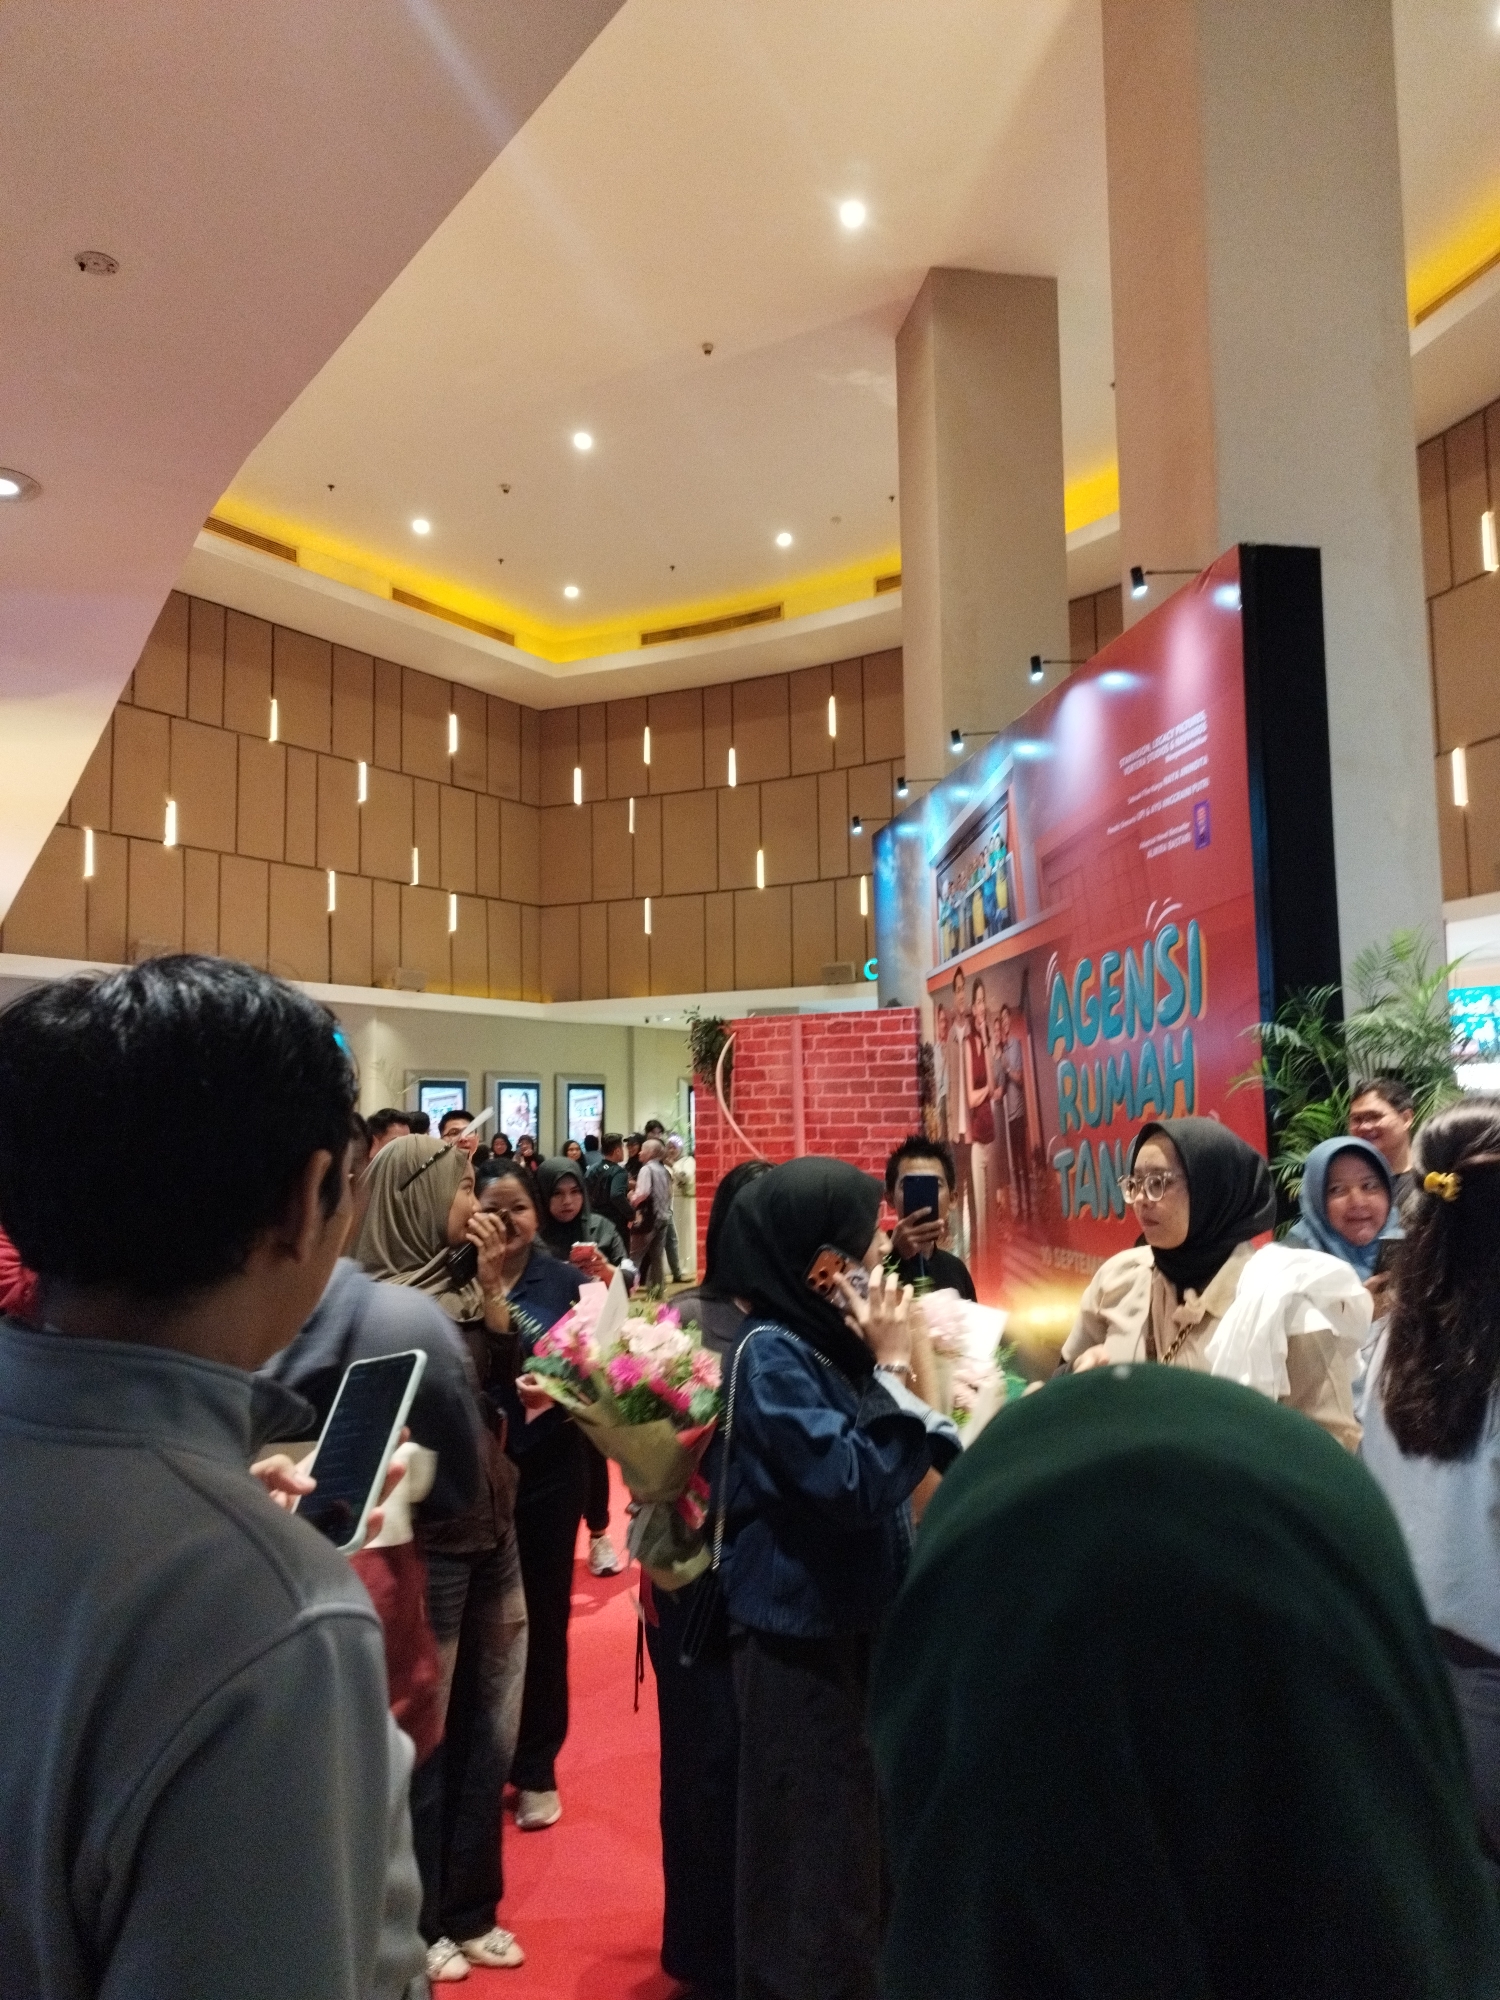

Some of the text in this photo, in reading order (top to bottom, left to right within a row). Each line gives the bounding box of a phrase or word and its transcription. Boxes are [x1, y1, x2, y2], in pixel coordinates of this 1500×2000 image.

[1047, 918, 1205, 1057] AGENSI
[1057, 1027, 1196, 1137] RUMAH
[1053, 1137, 1140, 1220] TAN
